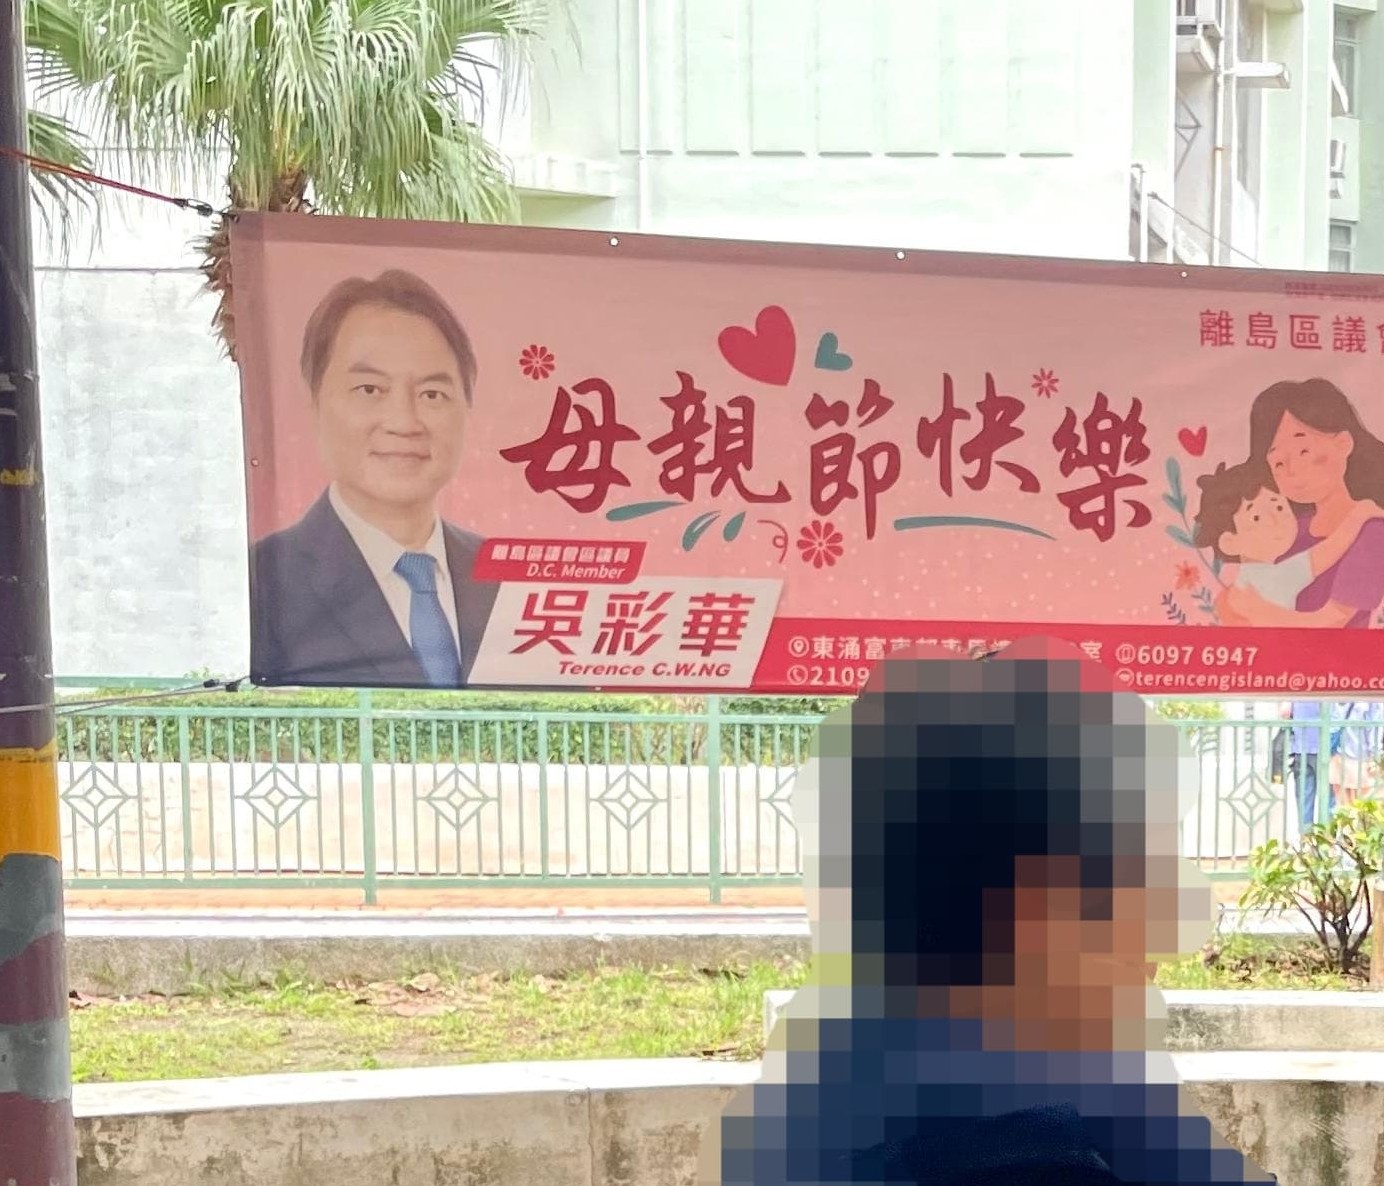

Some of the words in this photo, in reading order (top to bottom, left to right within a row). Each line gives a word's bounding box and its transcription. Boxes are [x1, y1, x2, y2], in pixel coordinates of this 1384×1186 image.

[500, 371, 1152, 542] 母親節快樂
[526, 563, 557, 577] D.C.
[561, 565, 626, 579] Member
[509, 590, 755, 657] 吳彩華
[1137, 645, 1194, 665] 6097
[1201, 646, 1259, 666] 6947
[559, 661, 645, 677] Terence
[652, 663, 732, 677] C.W.NG
